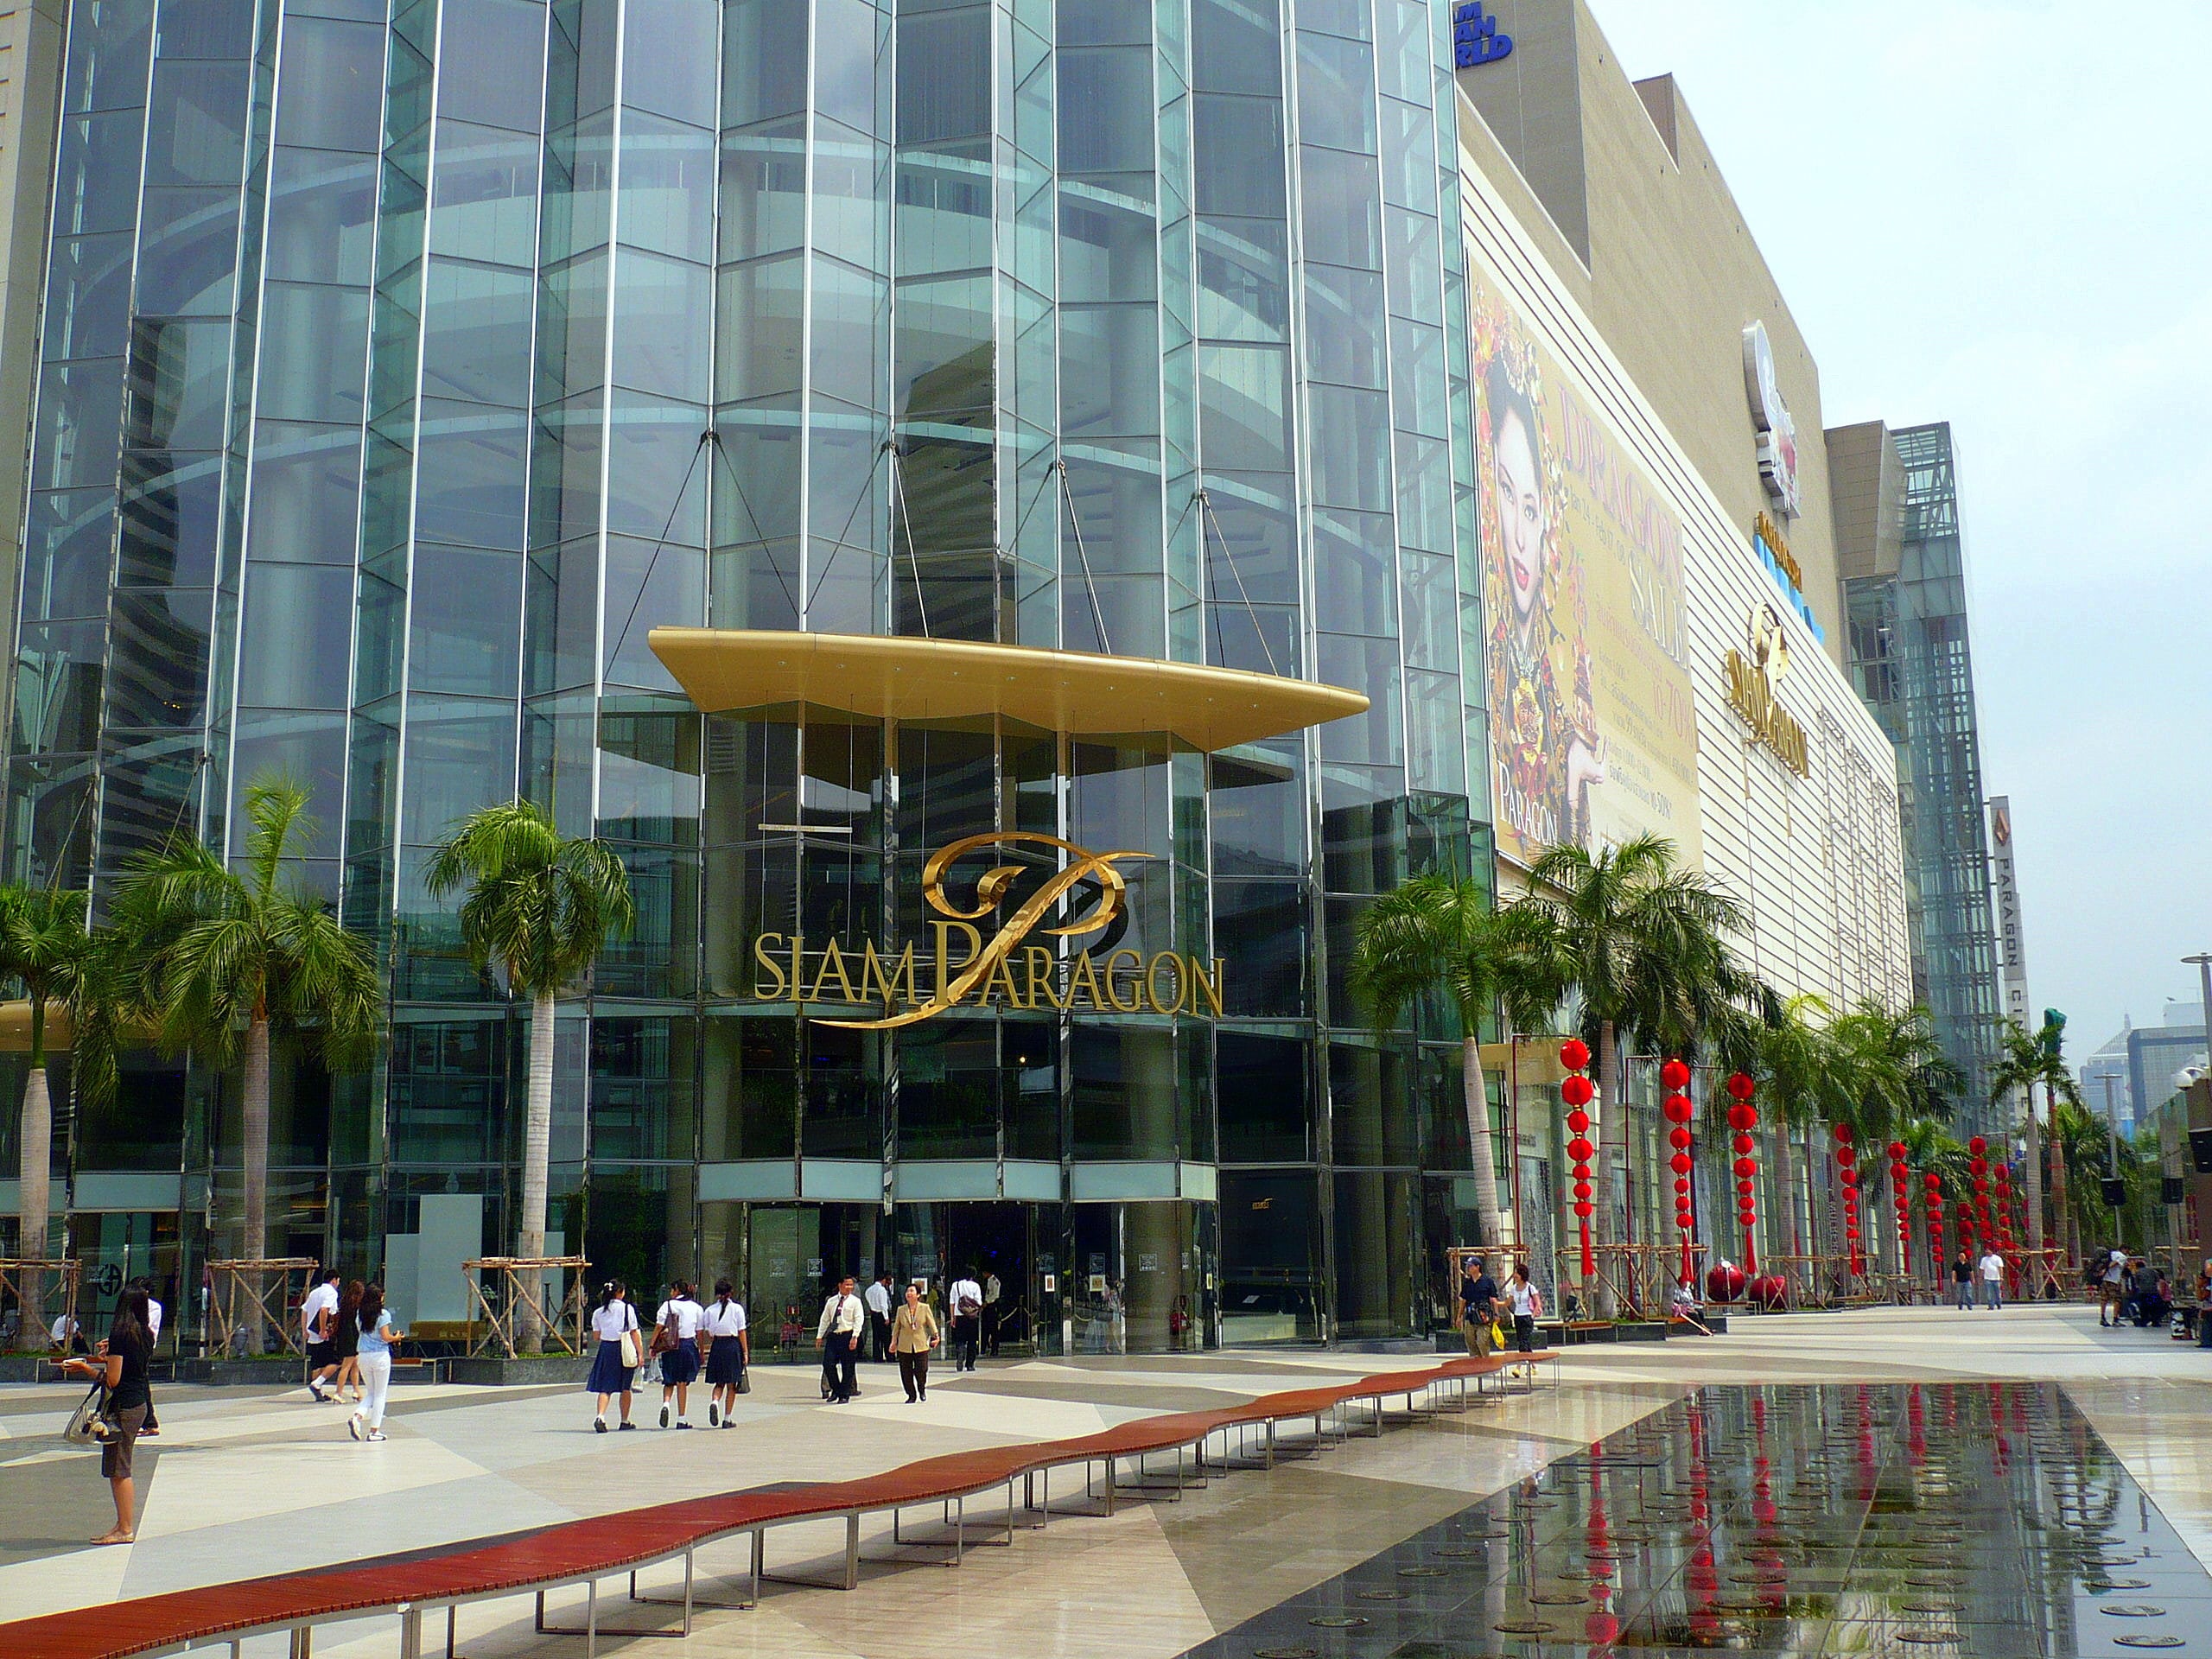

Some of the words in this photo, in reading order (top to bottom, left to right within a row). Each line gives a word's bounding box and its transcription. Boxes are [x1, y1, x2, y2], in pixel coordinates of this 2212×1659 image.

[1497, 760, 1558, 848] PARAGON
[1999, 858, 2018, 967] PARAGON
[753, 931, 921, 1006] SIAM
[926, 919, 1225, 1019] PARAGON
